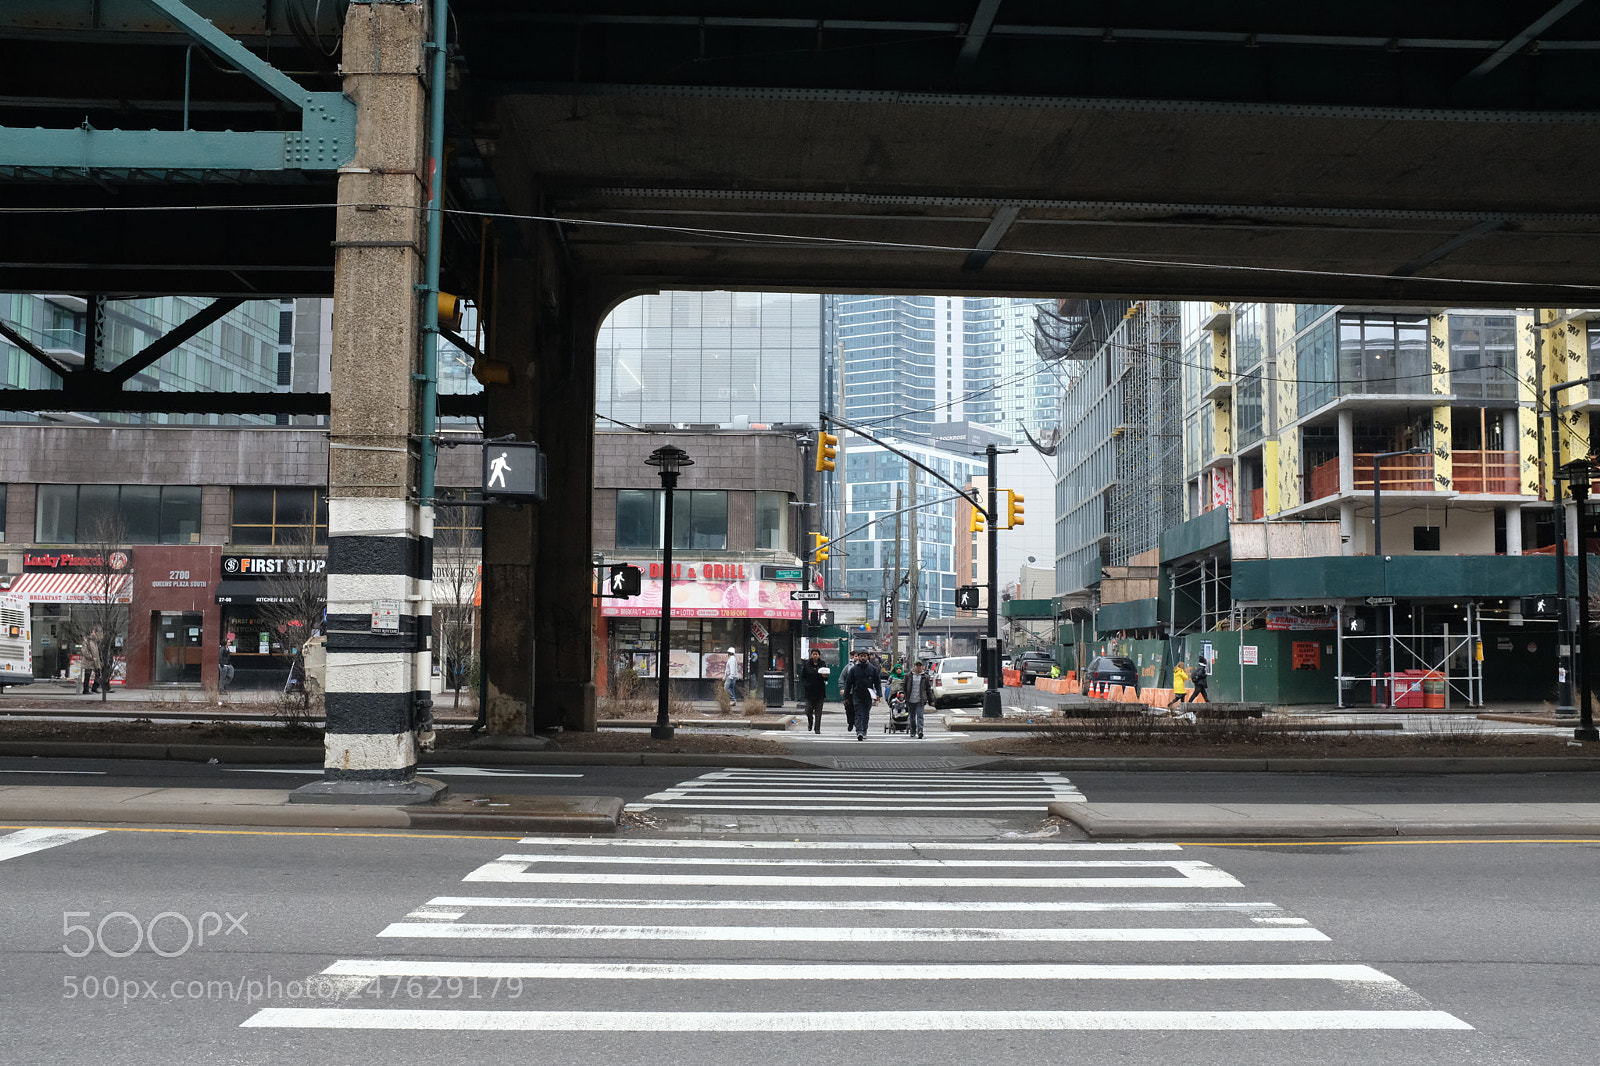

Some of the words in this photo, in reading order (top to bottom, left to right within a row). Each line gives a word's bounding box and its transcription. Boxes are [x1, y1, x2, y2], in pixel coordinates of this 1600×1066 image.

[1567, 324, 1581, 337] 3M
[1431, 336, 1445, 349] 3M
[1568, 350, 1582, 363] 3M
[1432, 362, 1446, 374] 3M
[1569, 411, 1582, 425] 3M
[1434, 420, 1448, 434] 3M
[1434, 447, 1449, 461] 3M
[1435, 474, 1450, 488] 3M
[24, 554, 60, 568] Lucky
[241, 559, 284, 573] FIRST
[287, 559, 326, 573] STOP
[169, 570, 190, 580] 2700
[688, 568, 696, 578] &
[703, 564, 745, 579] GRILL
[751, 623, 765, 640] ATM
